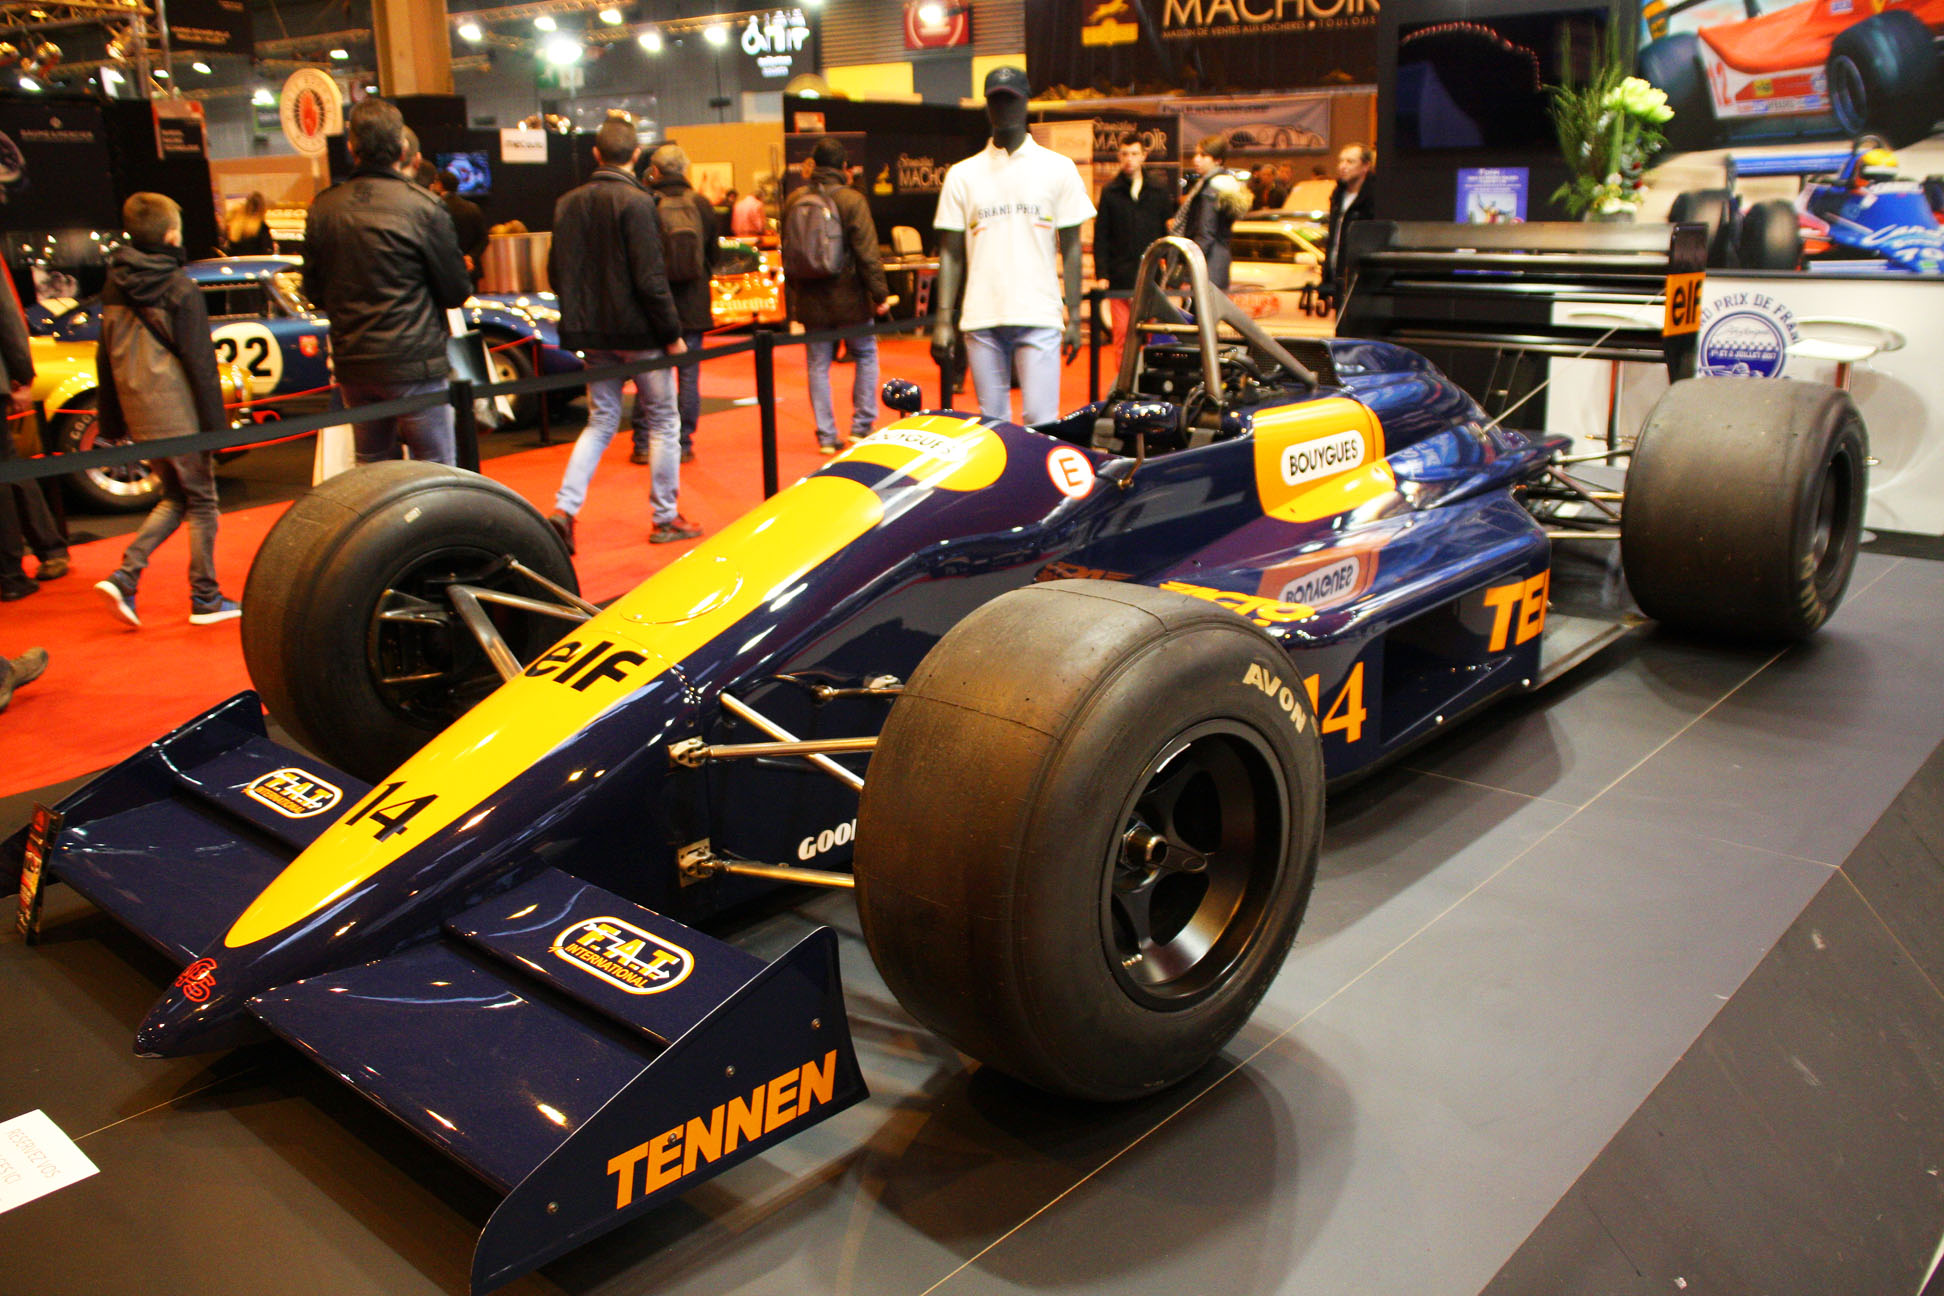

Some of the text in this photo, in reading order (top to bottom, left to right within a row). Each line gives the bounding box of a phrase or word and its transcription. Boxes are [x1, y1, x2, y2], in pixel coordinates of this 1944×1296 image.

[1162, 0, 1381, 27] MACH
[1319, 16, 1377, 28] TOULOUS
[1093, 128, 1168, 152] MAOÏR
[898, 162, 950, 188] MACHO
[1672, 278, 1702, 327] elf
[1712, 292, 1749, 312] PRIX
[1753, 292, 1774, 311] DE
[1058, 456, 1084, 488] E
[1289, 437, 1359, 477] BOUYGUES
[1483, 567, 1551, 653] TE
[523, 639, 649, 693] elf
[1242, 662, 1308, 735] AVON
[344, 780, 440, 844] 14
[563, 942, 650, 989] INTERNATIONAL
[606, 1048, 838, 1211] TENNEN
